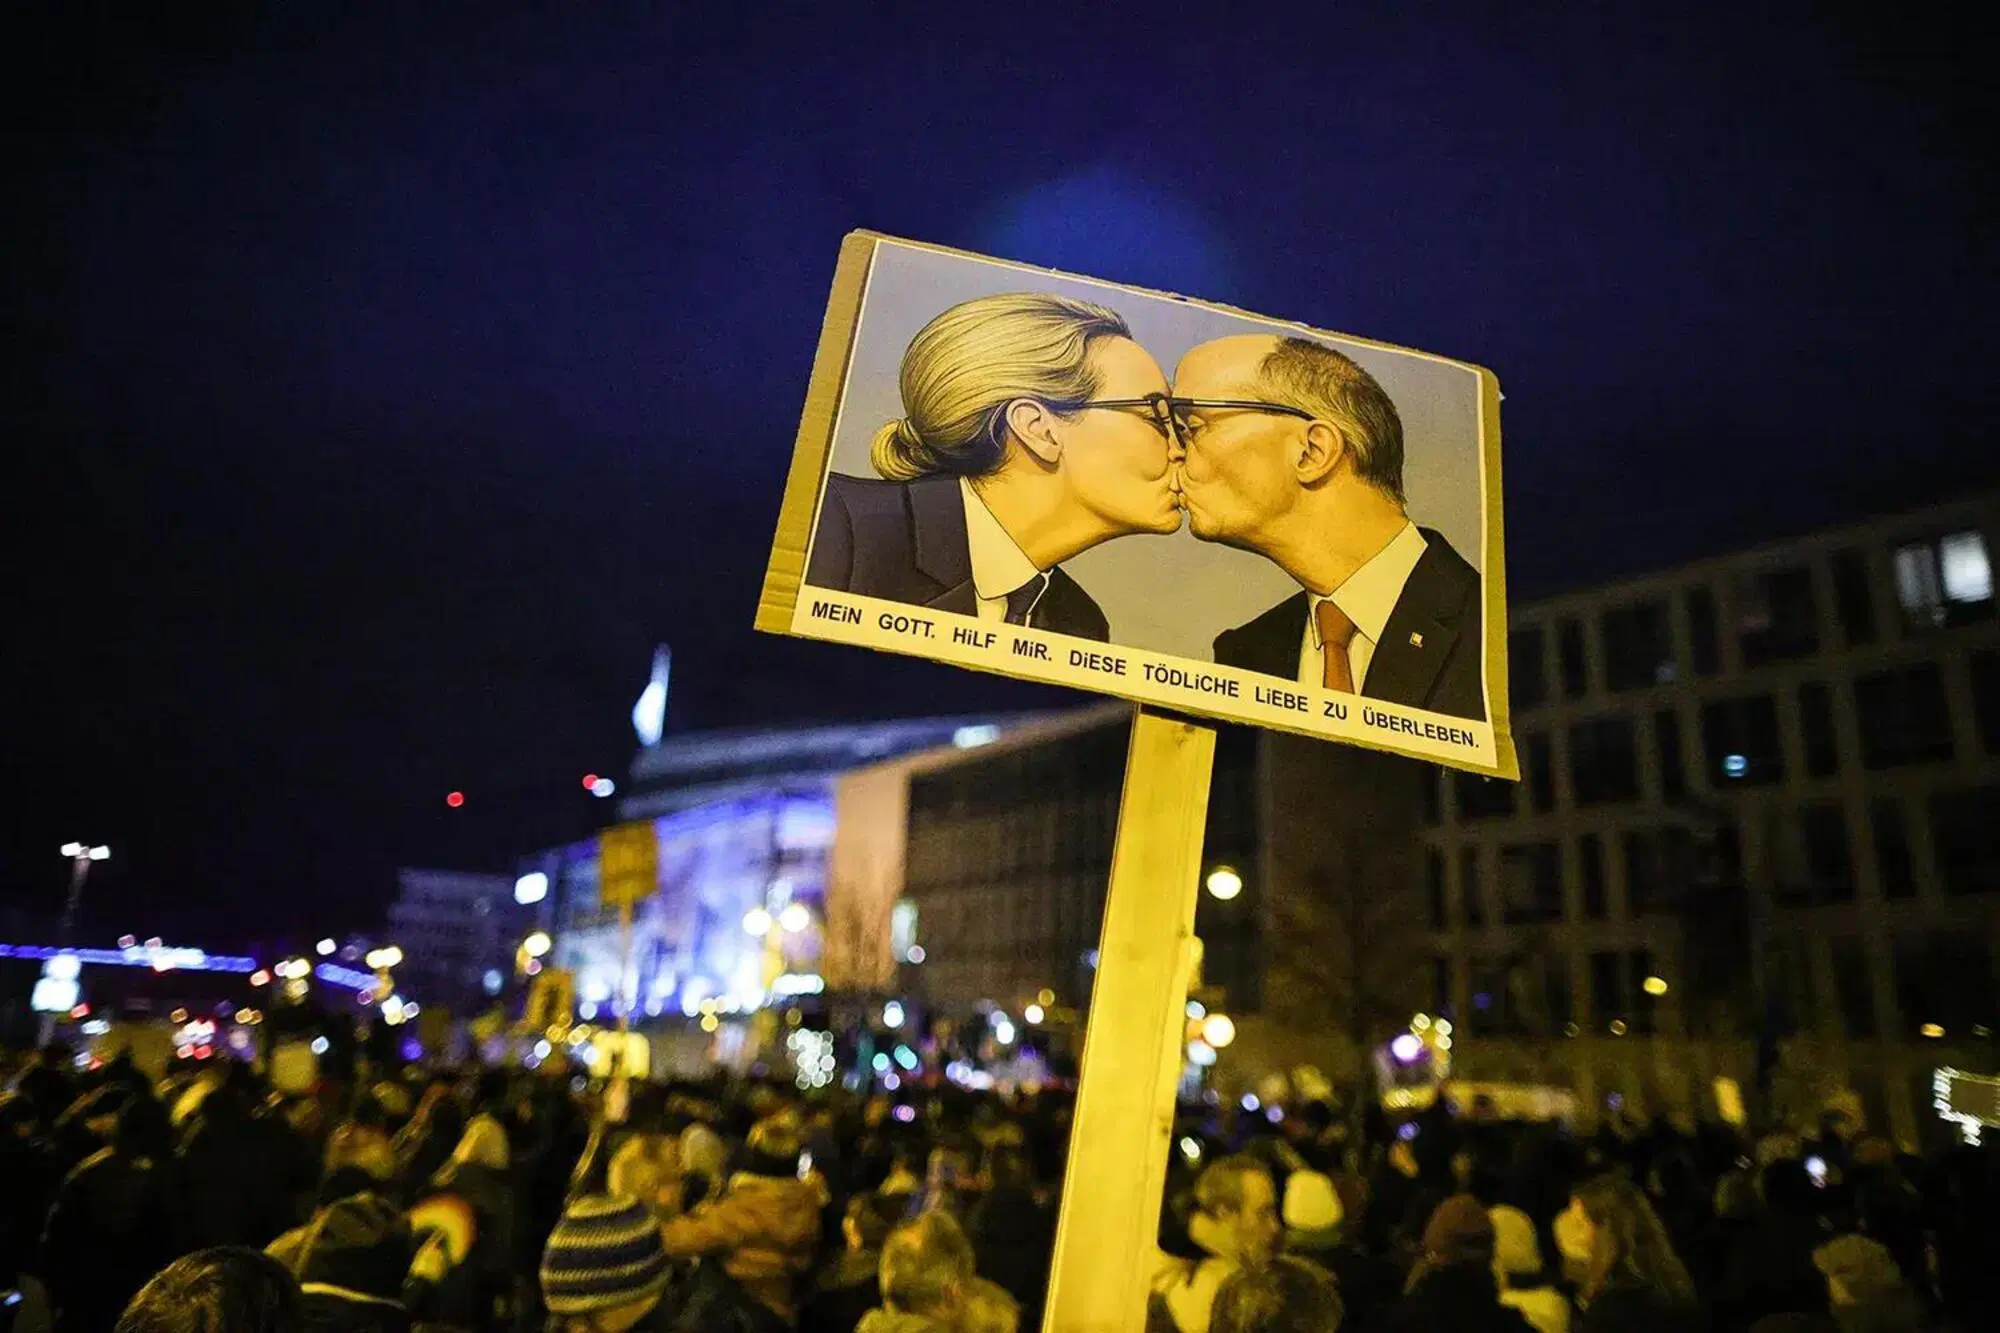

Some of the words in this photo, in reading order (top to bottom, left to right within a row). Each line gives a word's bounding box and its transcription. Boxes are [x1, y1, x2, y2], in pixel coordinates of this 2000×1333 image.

[811, 601, 862, 625] MEiN
[878, 613, 936, 638] GOTT.
[952, 627, 997, 649] HiLF
[1012, 638, 1052, 661] MiR.
[1069, 649, 1127, 676] DiESE
[1143, 662, 1239, 698] TÖDLiCHE
[1255, 686, 1309, 713] LiEBE
[1323, 701, 1348, 721] ZU
[1363, 706, 1480, 749] ÜBERLEBEN.
